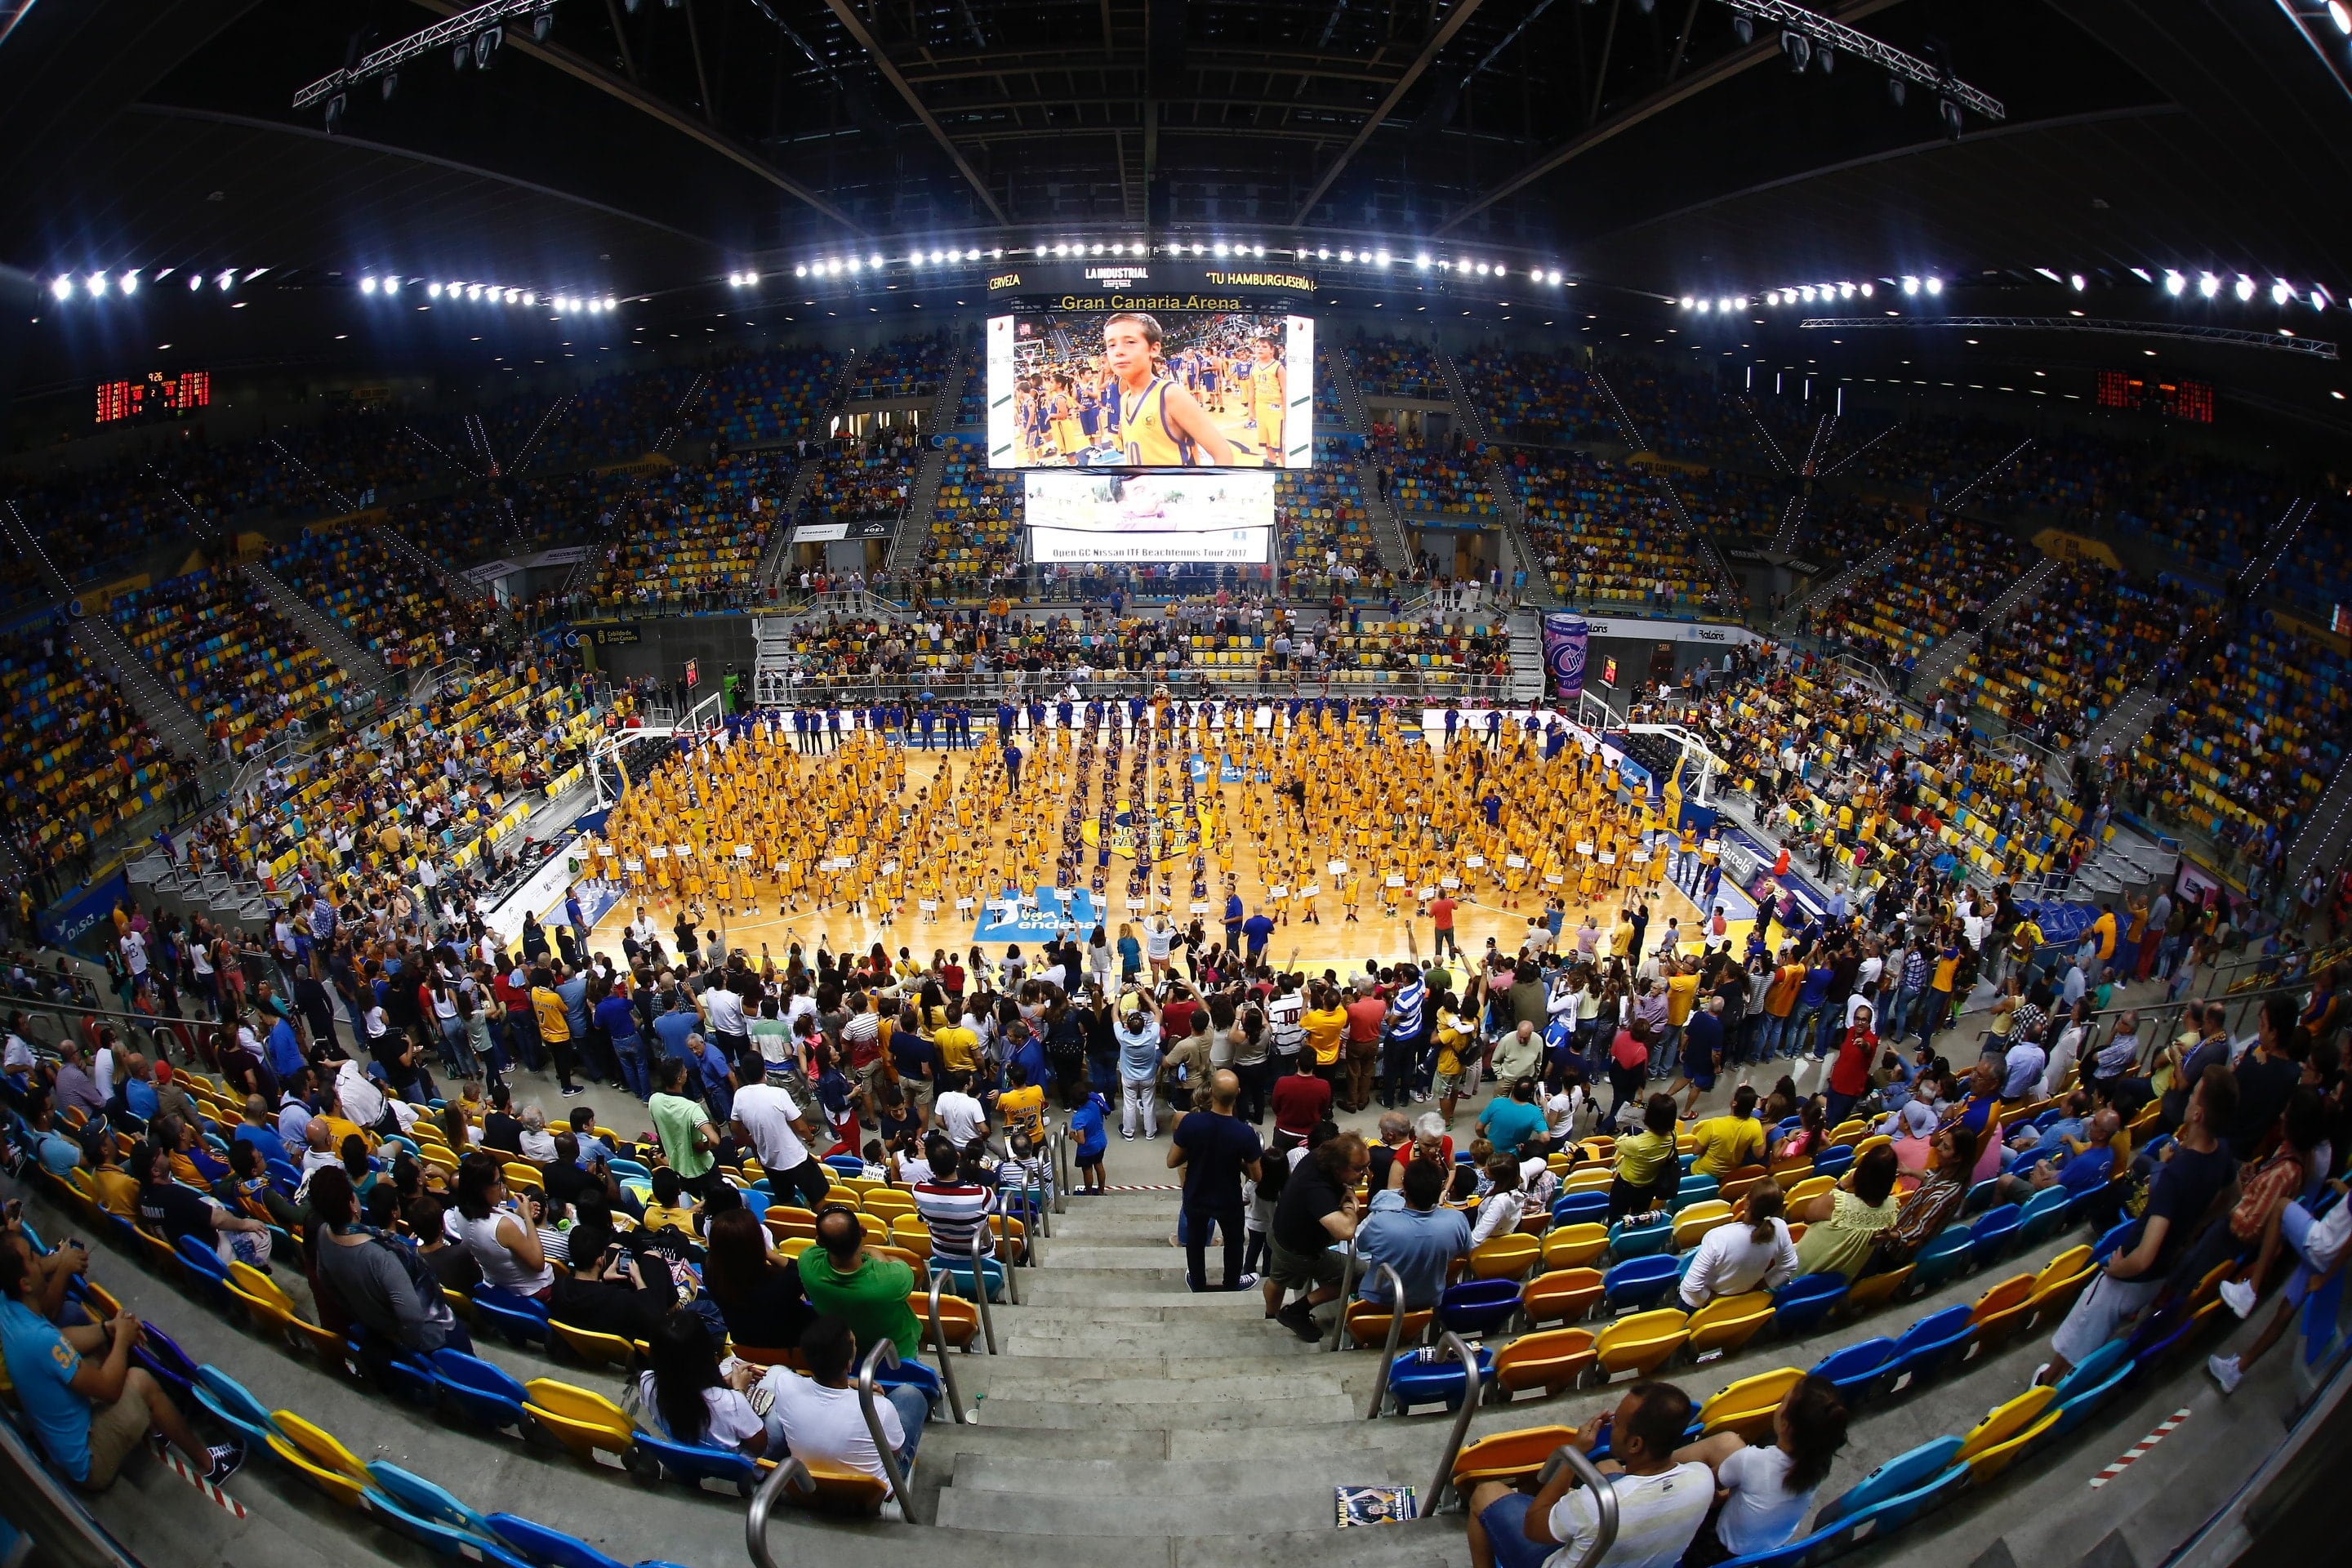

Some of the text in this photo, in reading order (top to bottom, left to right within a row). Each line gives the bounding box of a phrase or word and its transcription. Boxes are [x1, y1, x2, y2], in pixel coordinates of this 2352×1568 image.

[1097, 267, 1148, 279] INDUSTRIAL
[990, 274, 1021, 290] CERVEZA
[1227, 273, 1310, 292] HAMBURGUESERÍA
[1062, 295, 1241, 310] Gran Canaria Arena
[1053, 548, 1247, 558] Open GC Nissan ITF Beachtennis Tour 2017
[1720, 840, 1753, 874] Barceló
[1284, 1009, 1298, 1027] 10
